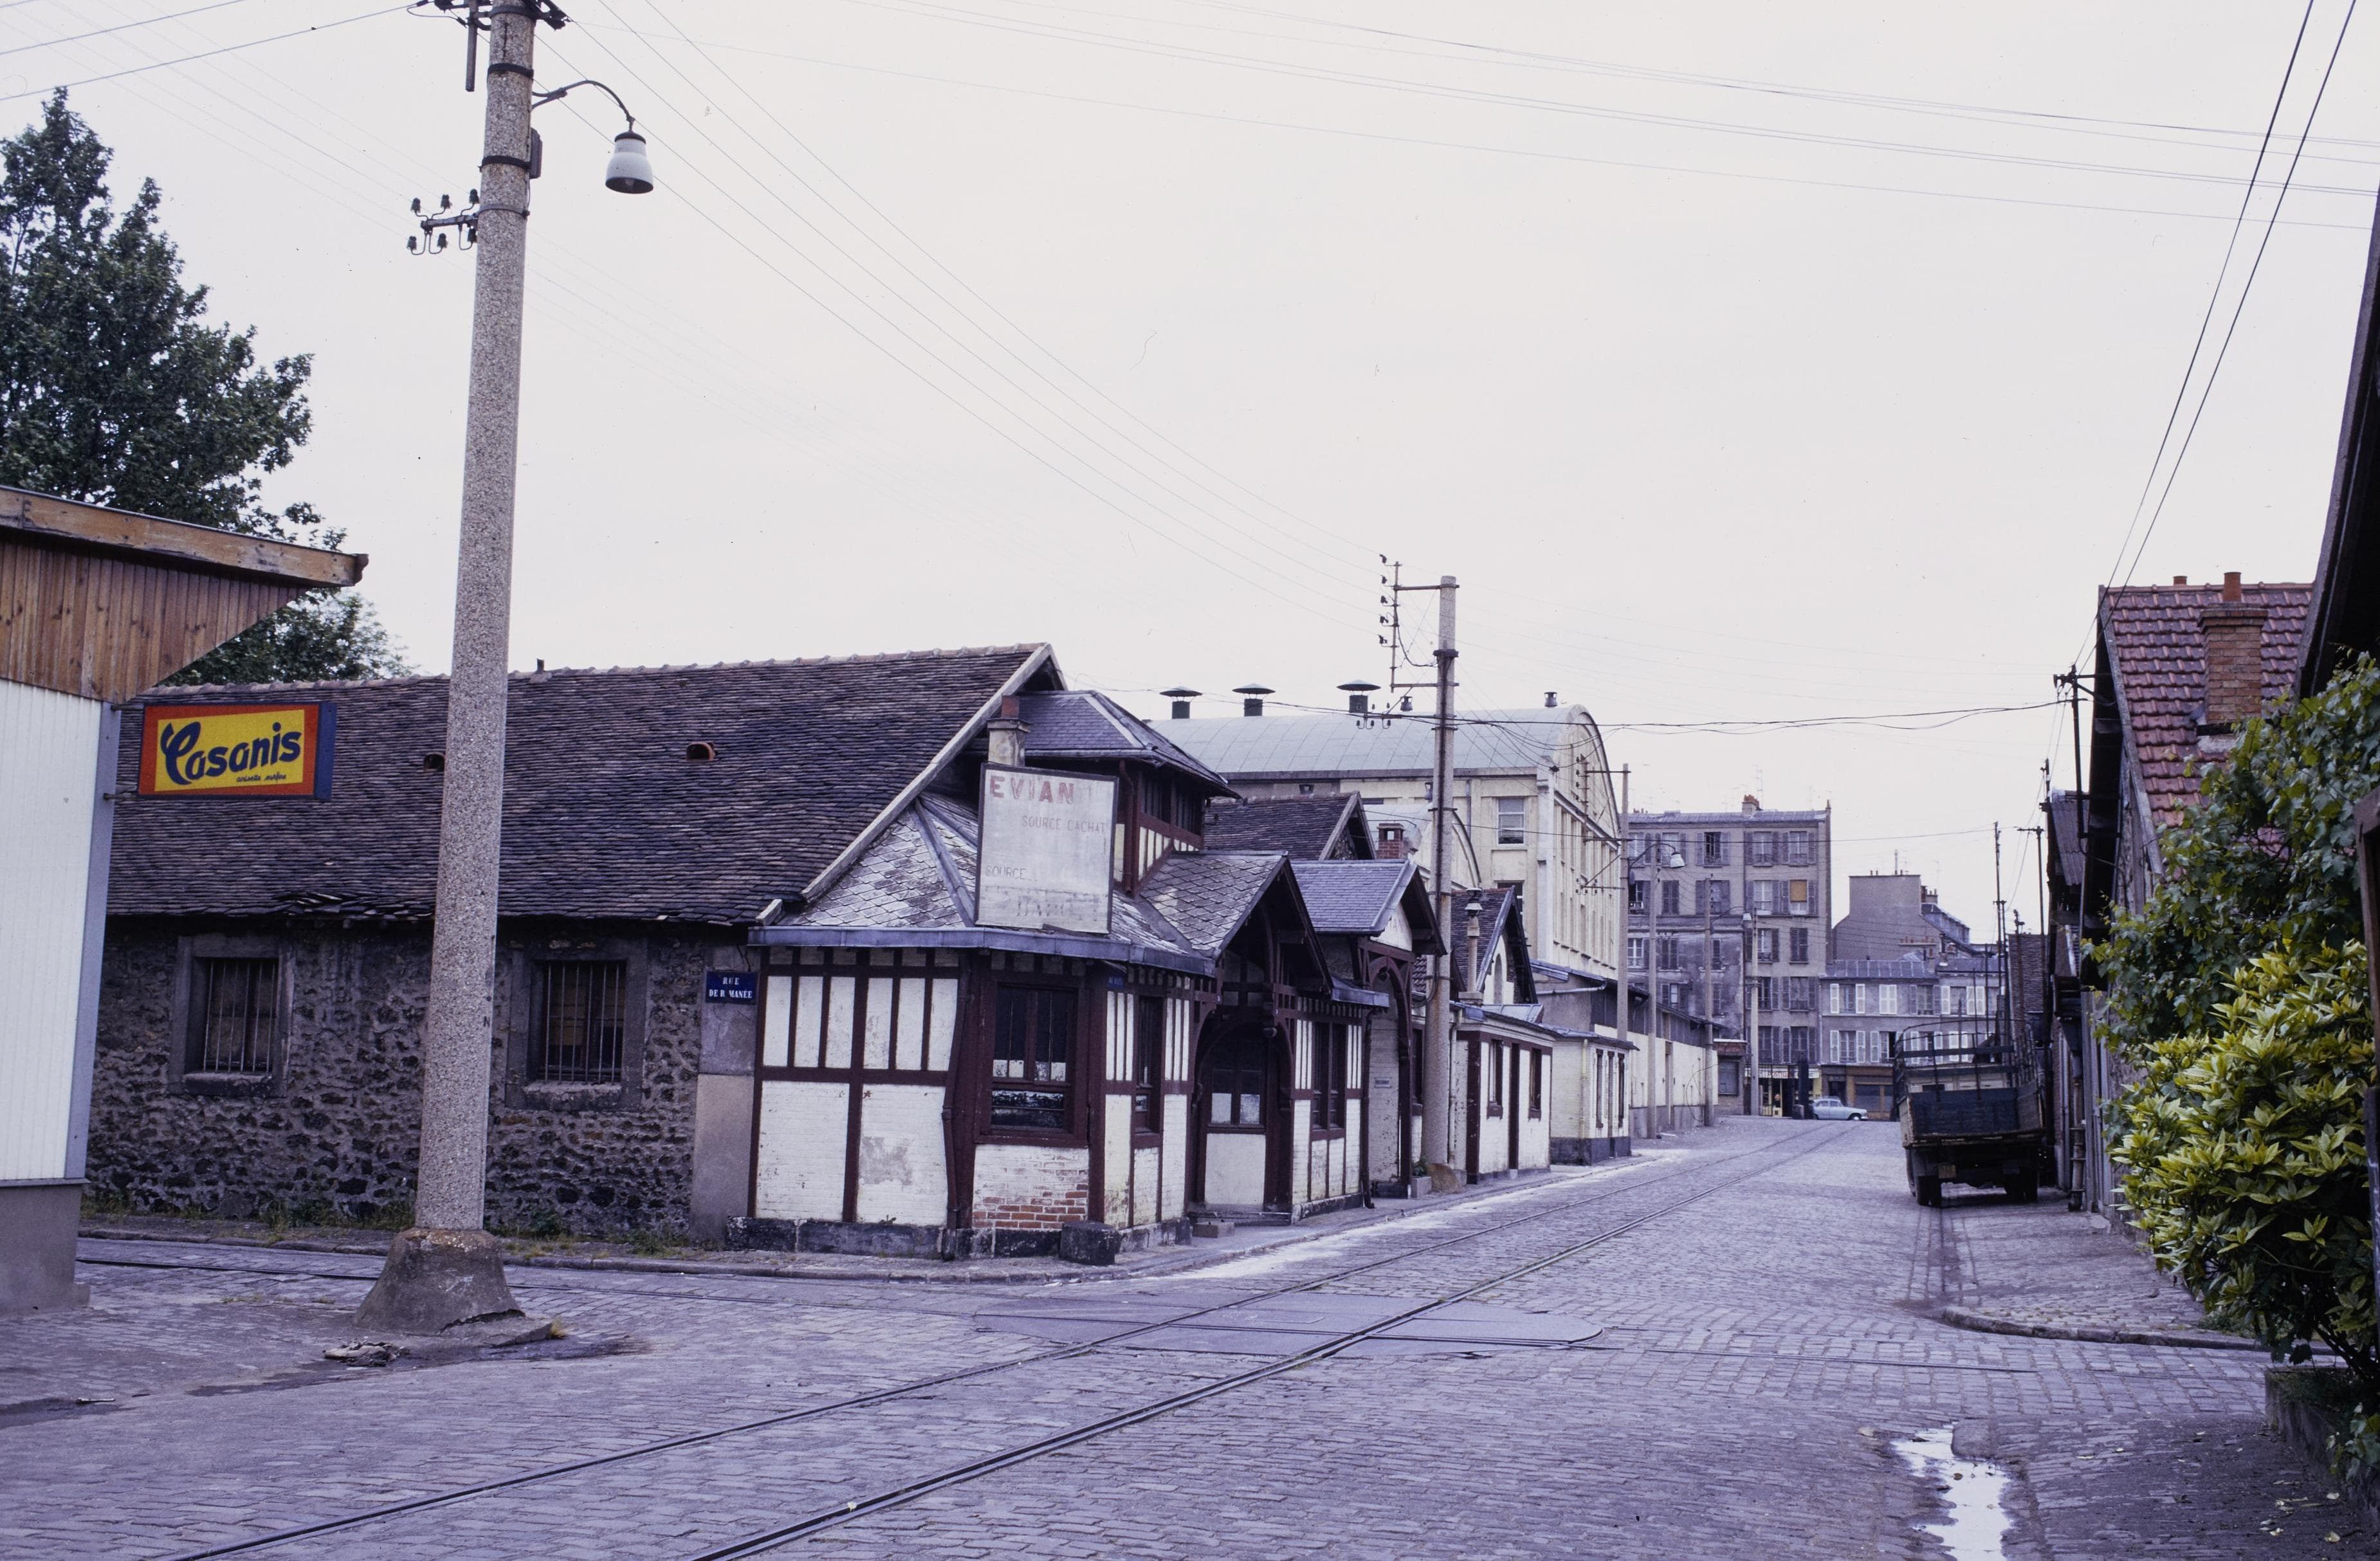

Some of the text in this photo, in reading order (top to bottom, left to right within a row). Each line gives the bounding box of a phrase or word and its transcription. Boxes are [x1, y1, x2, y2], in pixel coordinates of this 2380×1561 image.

[160, 721, 302, 785] Casanis
[989, 775, 1074, 804] EVIAN
[1022, 815, 1105, 834] SOURCE CACHAT
[709, 989, 719, 998] DE
